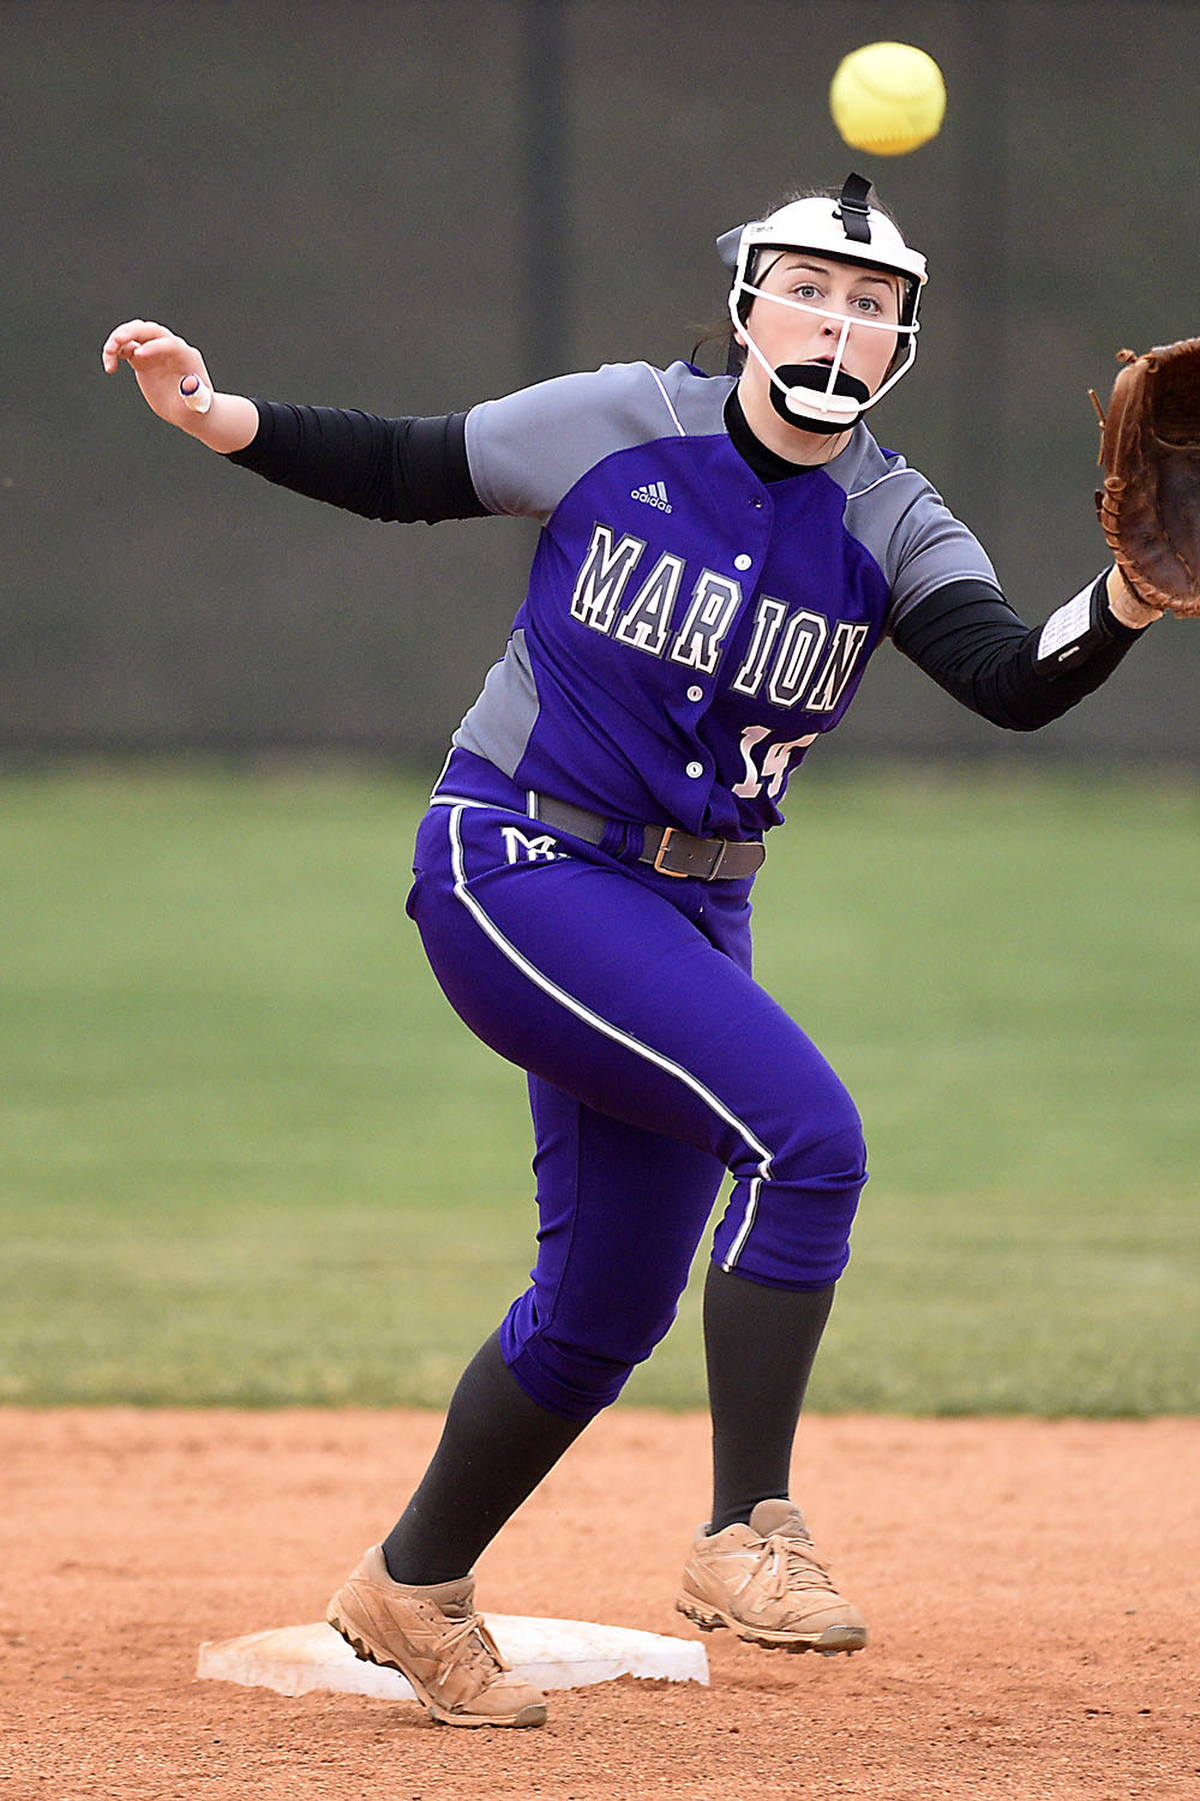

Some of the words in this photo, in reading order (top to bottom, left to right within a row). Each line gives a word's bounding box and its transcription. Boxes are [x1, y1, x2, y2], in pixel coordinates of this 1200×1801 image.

[630, 489, 673, 514] adidas
[570, 522, 870, 712] MARION
[731, 725, 819, 799] 14
